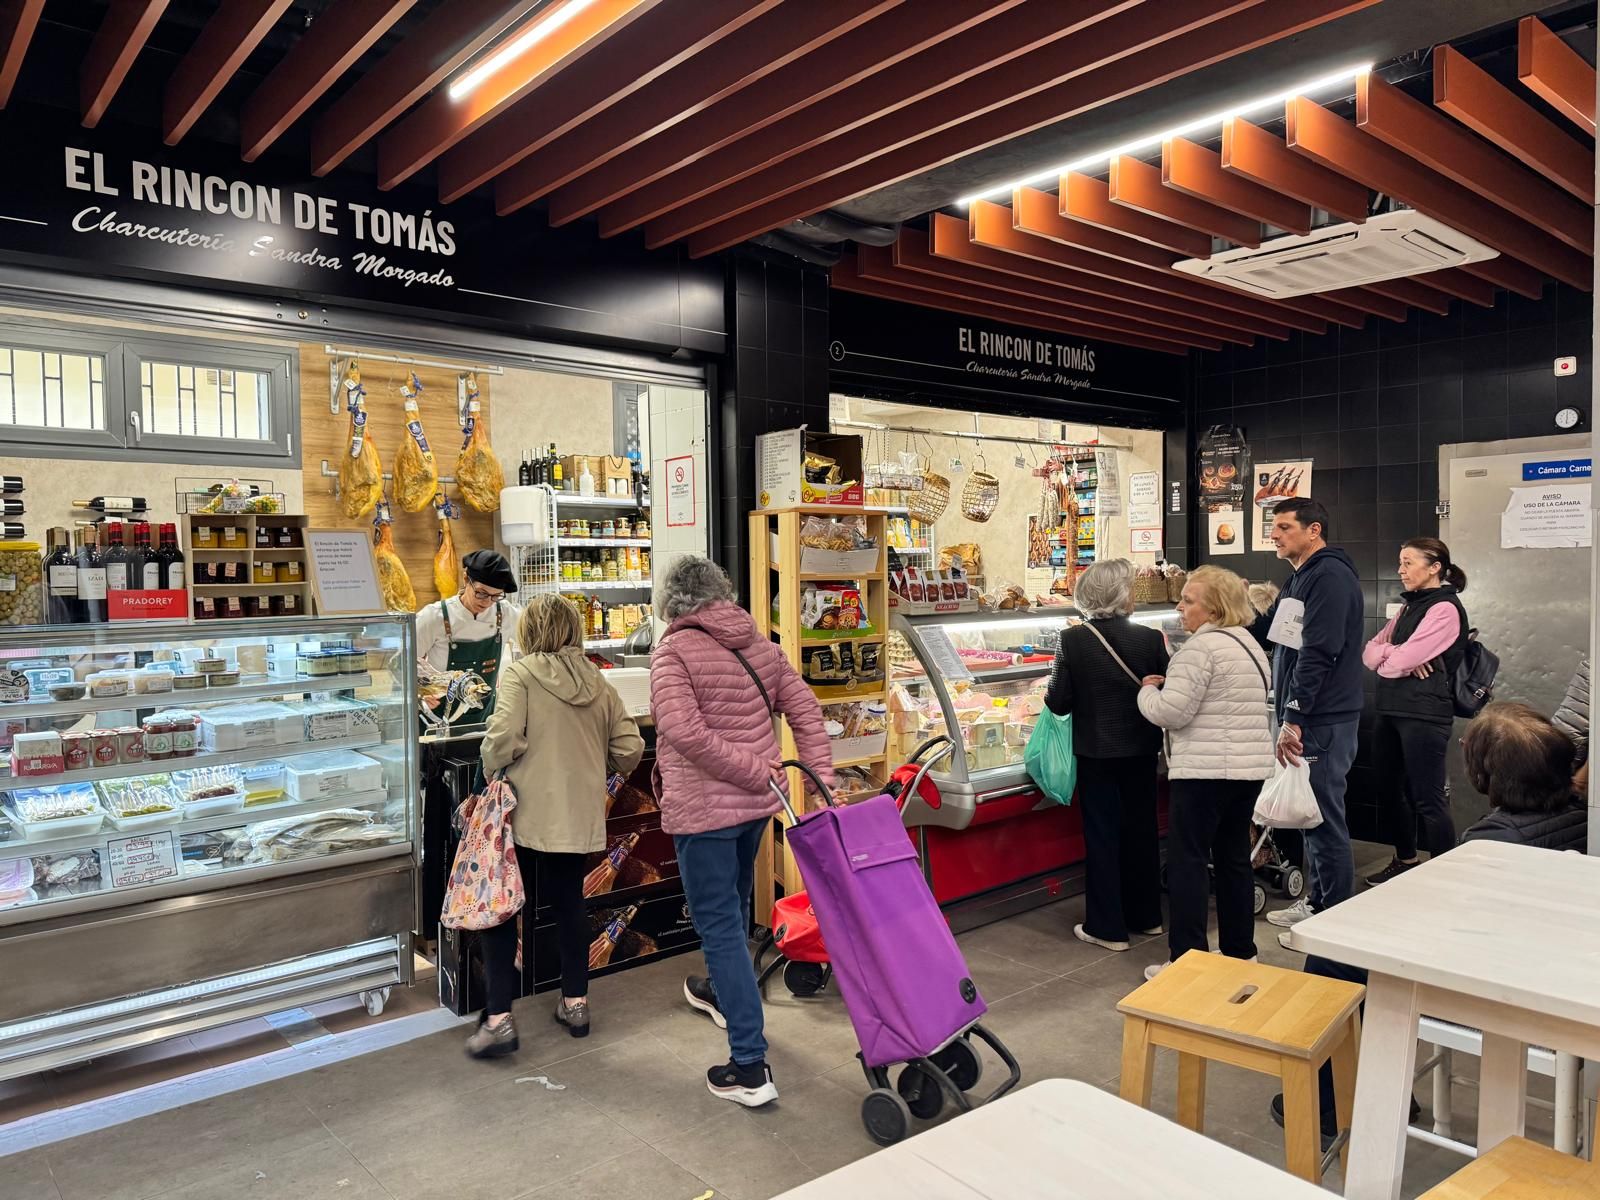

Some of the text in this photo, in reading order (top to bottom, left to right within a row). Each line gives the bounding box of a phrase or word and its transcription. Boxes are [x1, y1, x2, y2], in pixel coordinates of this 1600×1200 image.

[65, 146, 457, 256] EL RINCON DE TOMÁS
[71, 206, 455, 287] Charcutería Sandra Morgado
[959, 327, 1096, 372] EL RINCON DE TOMÁS
[966, 360, 1091, 390] Charcutería Sandra Morgado
[1538, 466, 1566, 474] Cámara
[123, 598, 174, 606] PRADOREY
